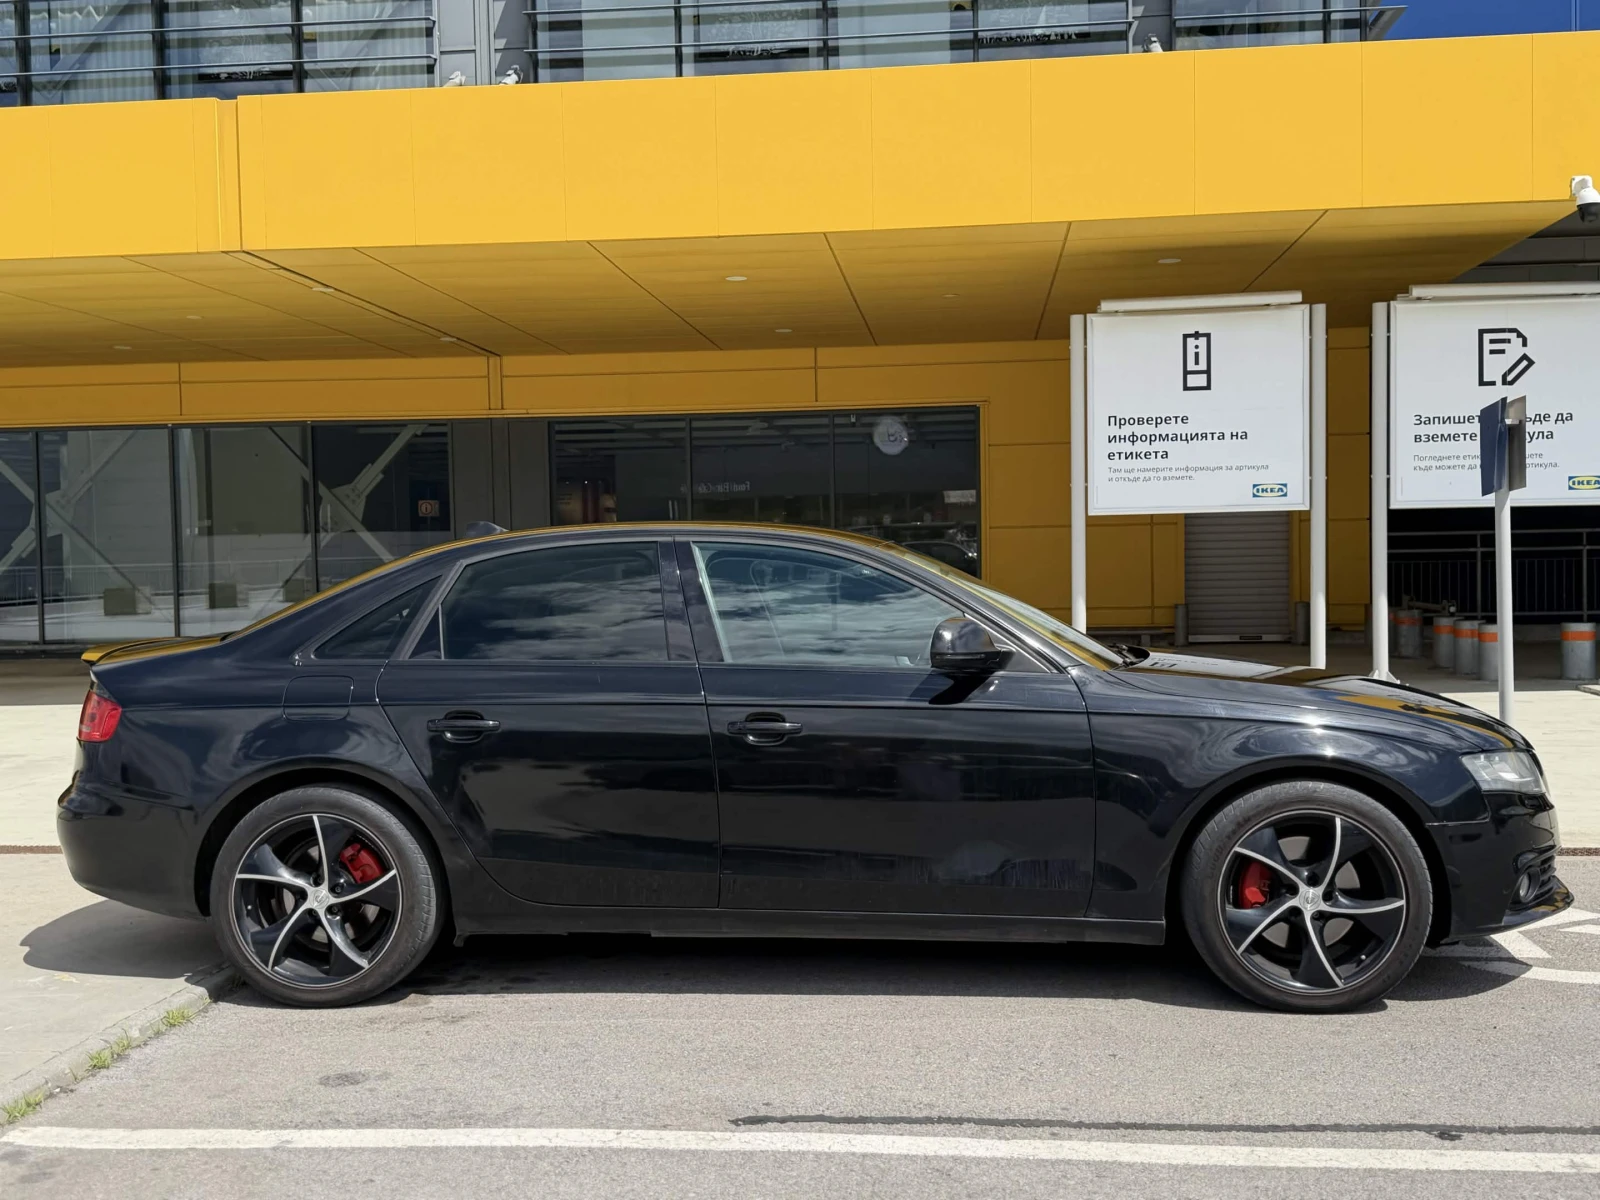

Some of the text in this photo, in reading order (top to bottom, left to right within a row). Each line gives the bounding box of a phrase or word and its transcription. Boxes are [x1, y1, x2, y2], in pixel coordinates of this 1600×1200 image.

[1107, 415, 1189, 429] Проверете
[1413, 414, 1481, 426] Запишет
[1554, 412, 1573, 424] да
[1107, 430, 1249, 446] информацията на
[1414, 432, 1478, 443] вземете
[1107, 450, 1169, 461] етикета
[1413, 454, 1461, 463] Погледнете
[1123, 466, 1135, 474] ще
[1136, 465, 1173, 474] намерите
[1174, 464, 1223, 473] информация
[1234, 463, 1269, 472] артикула
[1413, 464, 1433, 472] къде
[1142, 475, 1151, 483] да
